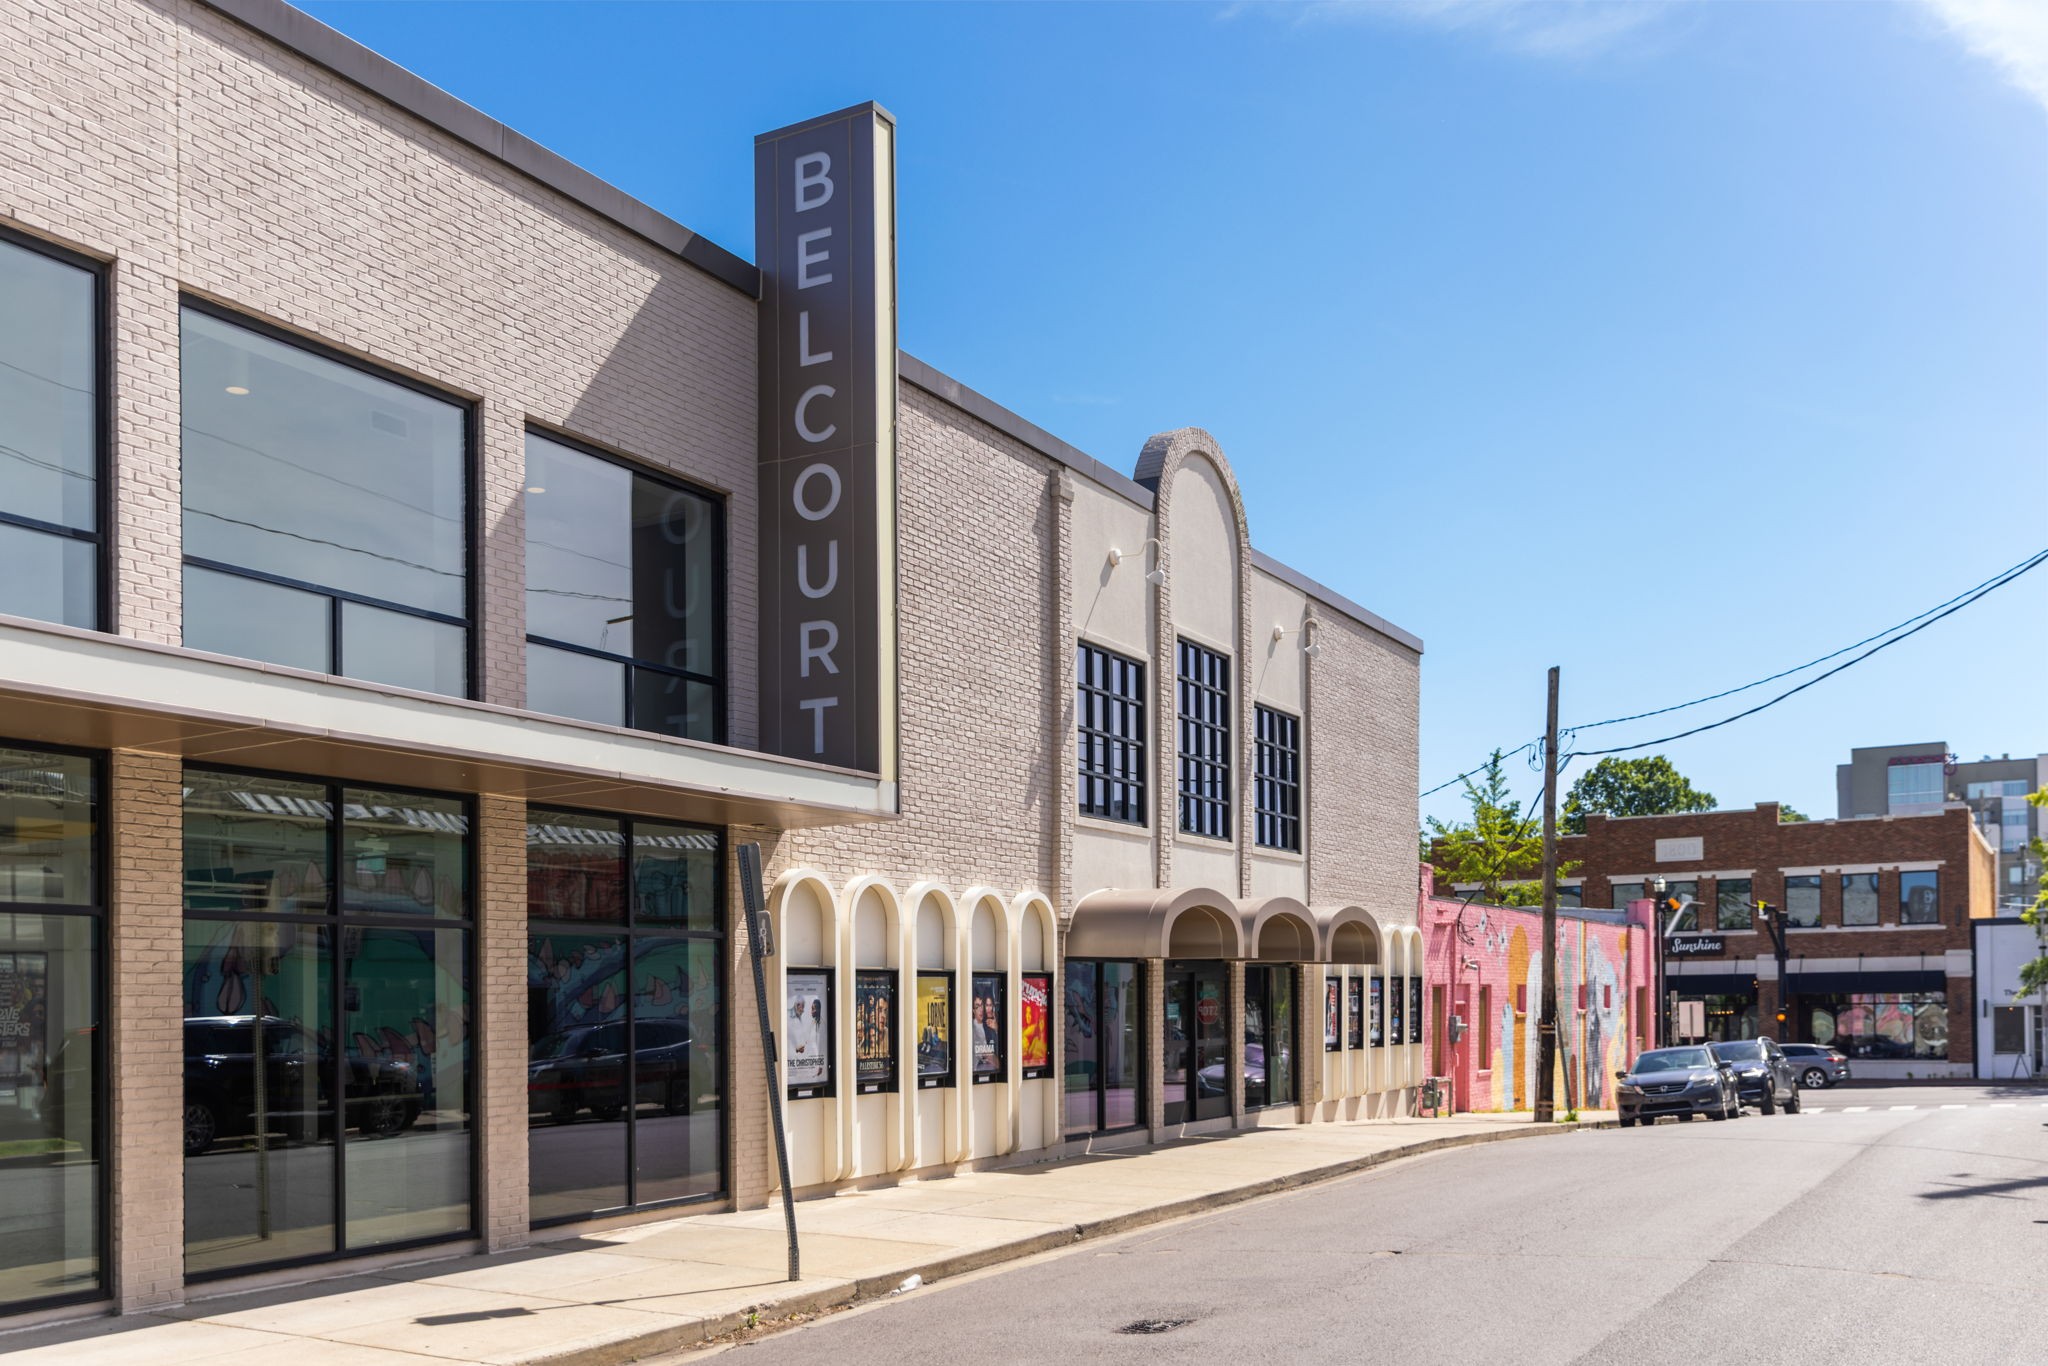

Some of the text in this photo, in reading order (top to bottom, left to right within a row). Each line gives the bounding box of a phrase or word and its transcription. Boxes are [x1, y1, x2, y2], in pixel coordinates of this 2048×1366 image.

[793, 151, 842, 754] BELCOURT
[1672, 938, 1722, 953] Sunshine
[975, 1044, 995, 1054] DRAMA
[787, 1059, 795, 1067] THE
